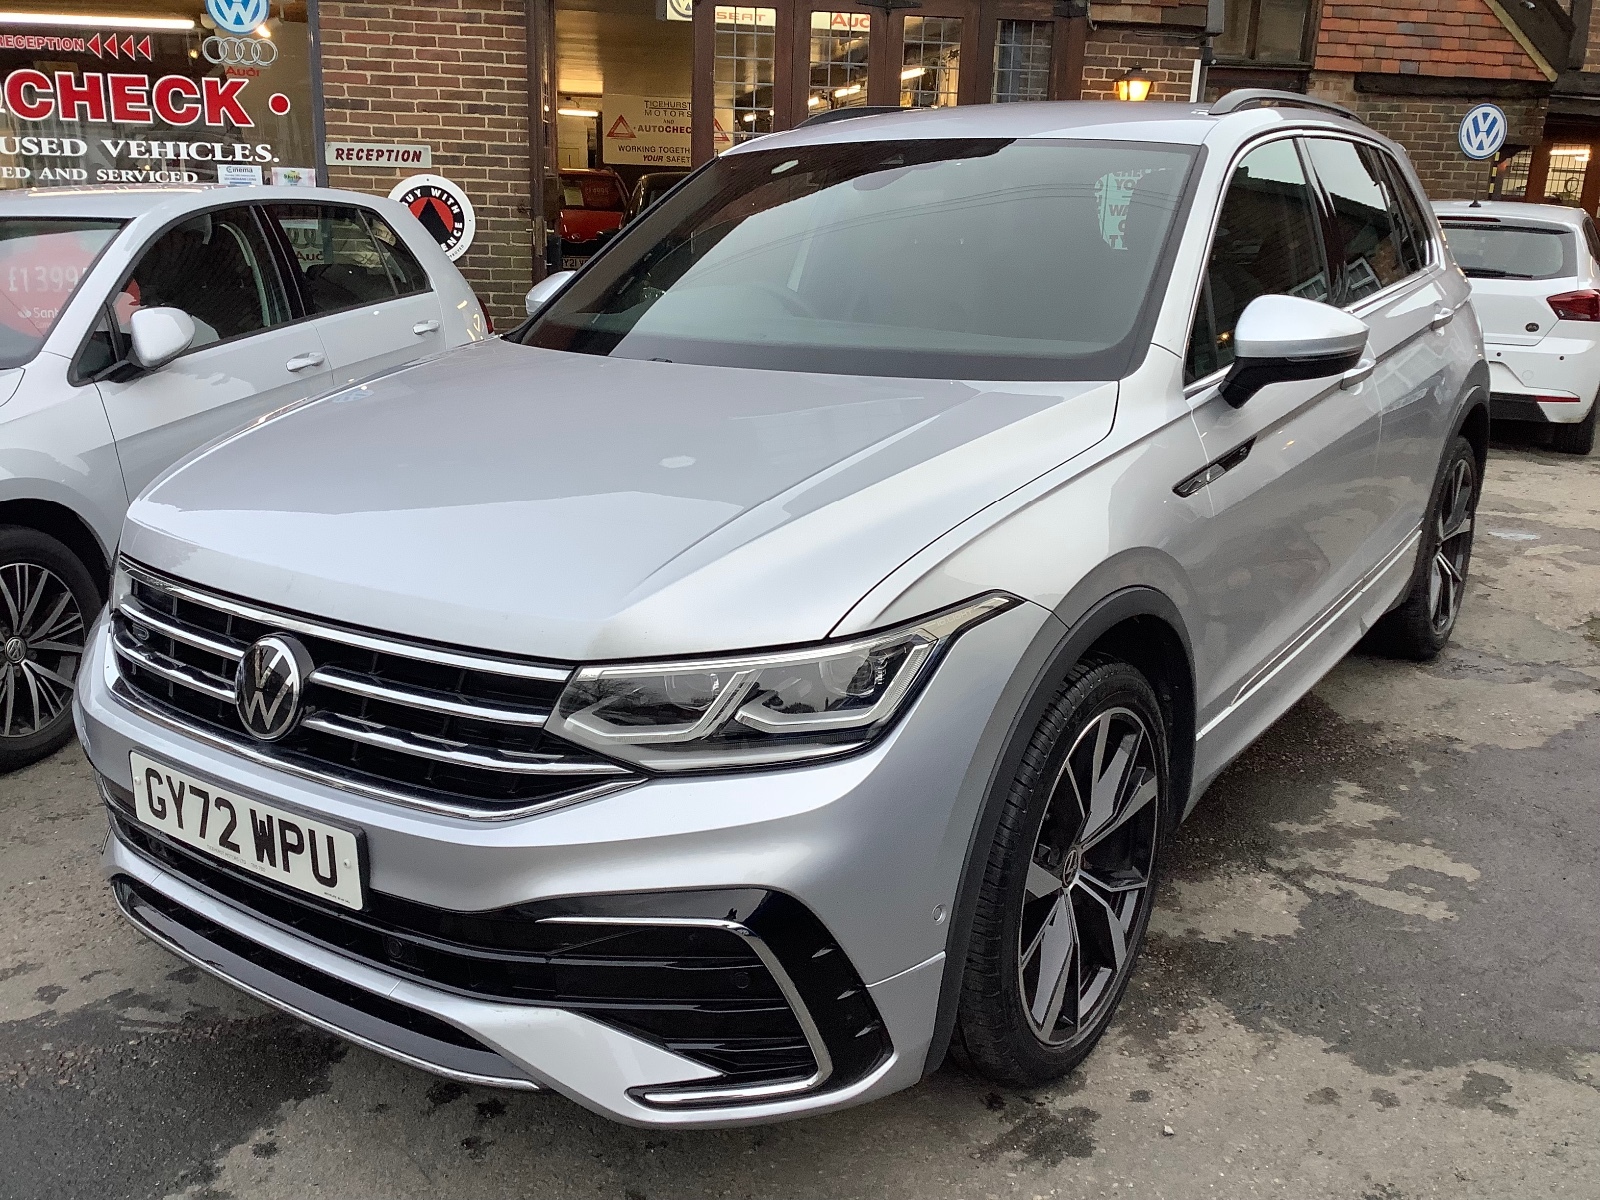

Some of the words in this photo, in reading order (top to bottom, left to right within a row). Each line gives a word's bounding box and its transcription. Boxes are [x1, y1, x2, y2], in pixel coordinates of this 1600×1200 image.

[716, 11, 766, 22] SEAT
[225, 66, 260, 77] Audi
[0, 69, 255, 128] CHECK
[643, 100, 691, 110] TICEHURST
[644, 110, 692, 118] MOTORS
[637, 124, 691, 134] AUTOCHEC
[101, 139, 280, 163] VEHICLES.
[335, 147, 422, 163] RECEPTION
[618, 145, 656, 153] WORKING
[659, 146, 690, 154] TOGETH
[643, 154, 664, 162] YOUR
[666, 155, 690, 164] SAFET
[0, 166, 31, 180] ED
[39, 167, 88, 181] AND
[96, 169, 198, 184] SERVICED
[226, 165, 253, 174] Cinema
[402, 188, 422, 206] UY
[430, 187, 461, 215] WITH
[440, 221, 463, 252] ENCE
[144, 767, 241, 855] GY72
[249, 807, 338, 889] WPU
